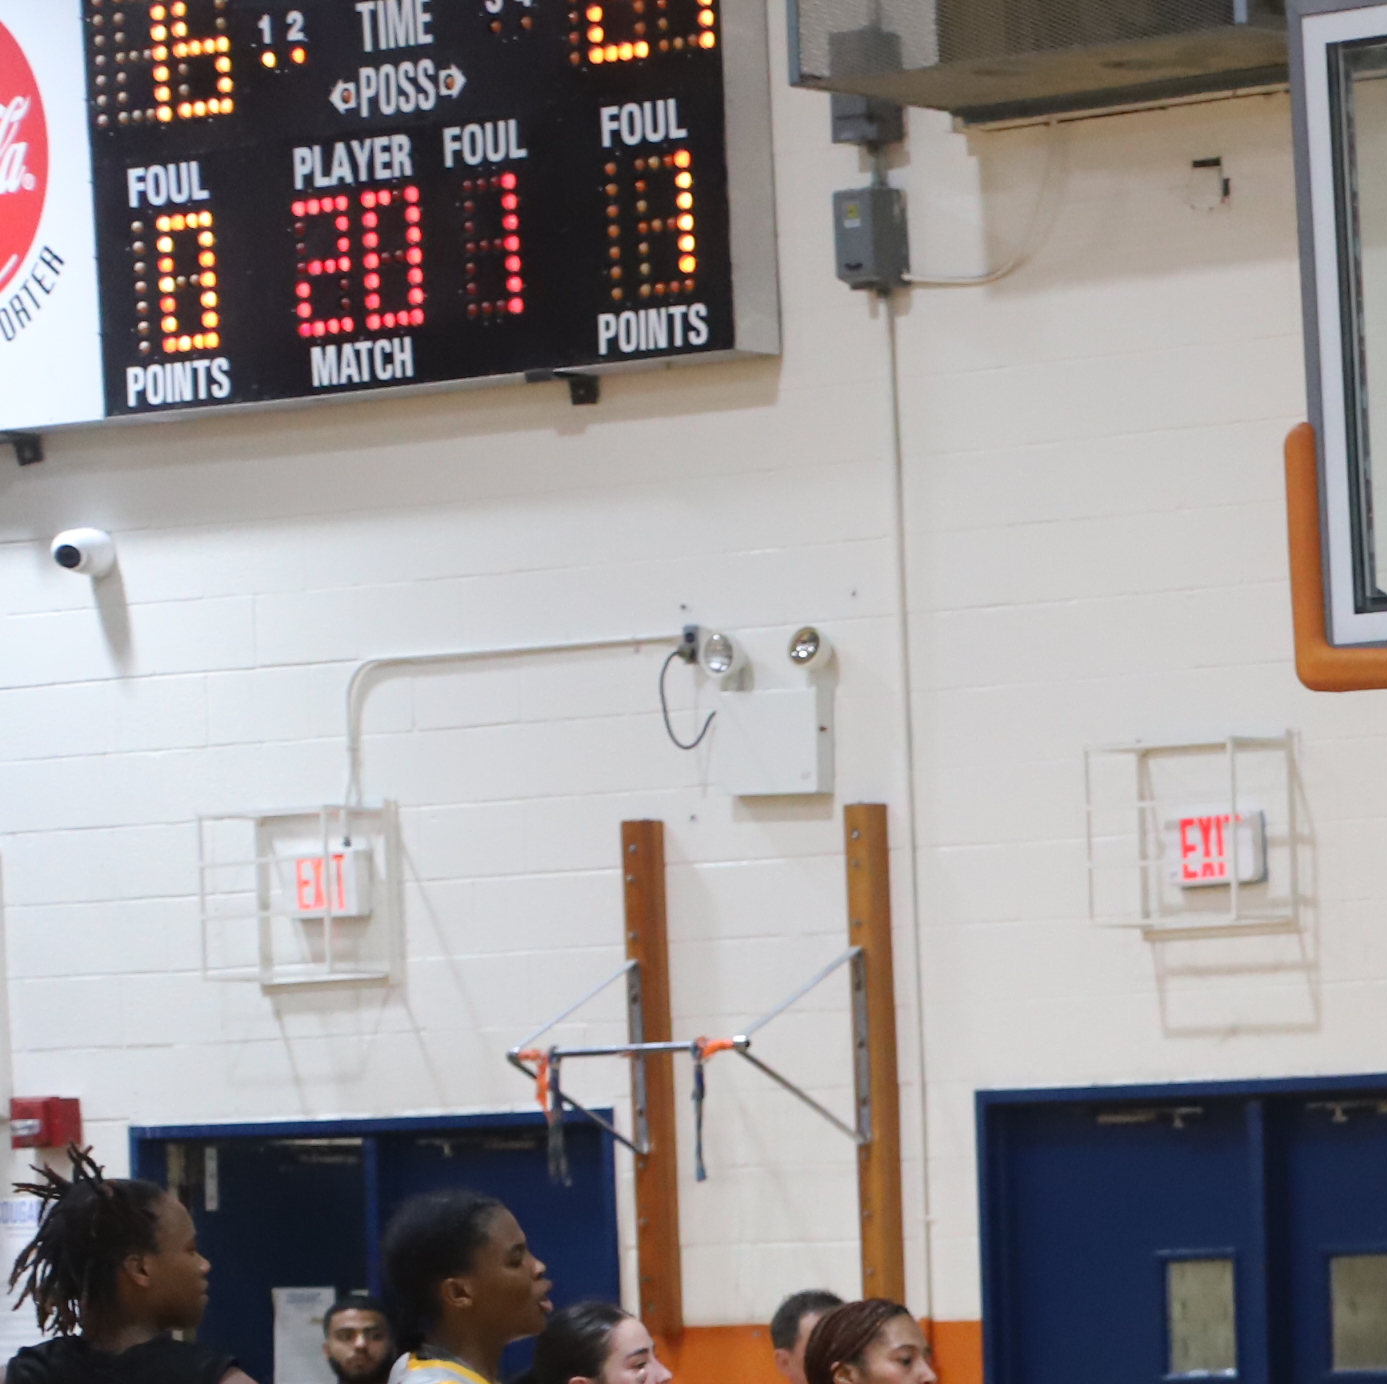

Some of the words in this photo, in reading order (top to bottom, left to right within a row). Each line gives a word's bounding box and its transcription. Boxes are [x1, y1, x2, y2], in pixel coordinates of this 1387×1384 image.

[356, 0, 434, 52] TIME
[359, 58, 436, 117] POSS
[442, 119, 528, 168] FOUL
[600, 98, 688, 148] FOUL
[127, 160, 209, 208] FOUL
[292, 133, 414, 191] PLAYER
[291, 185, 424, 338] 20
[597, 304, 709, 355] POINTS
[126, 357, 231, 407] POINTS
[310, 337, 414, 388] MATCH
